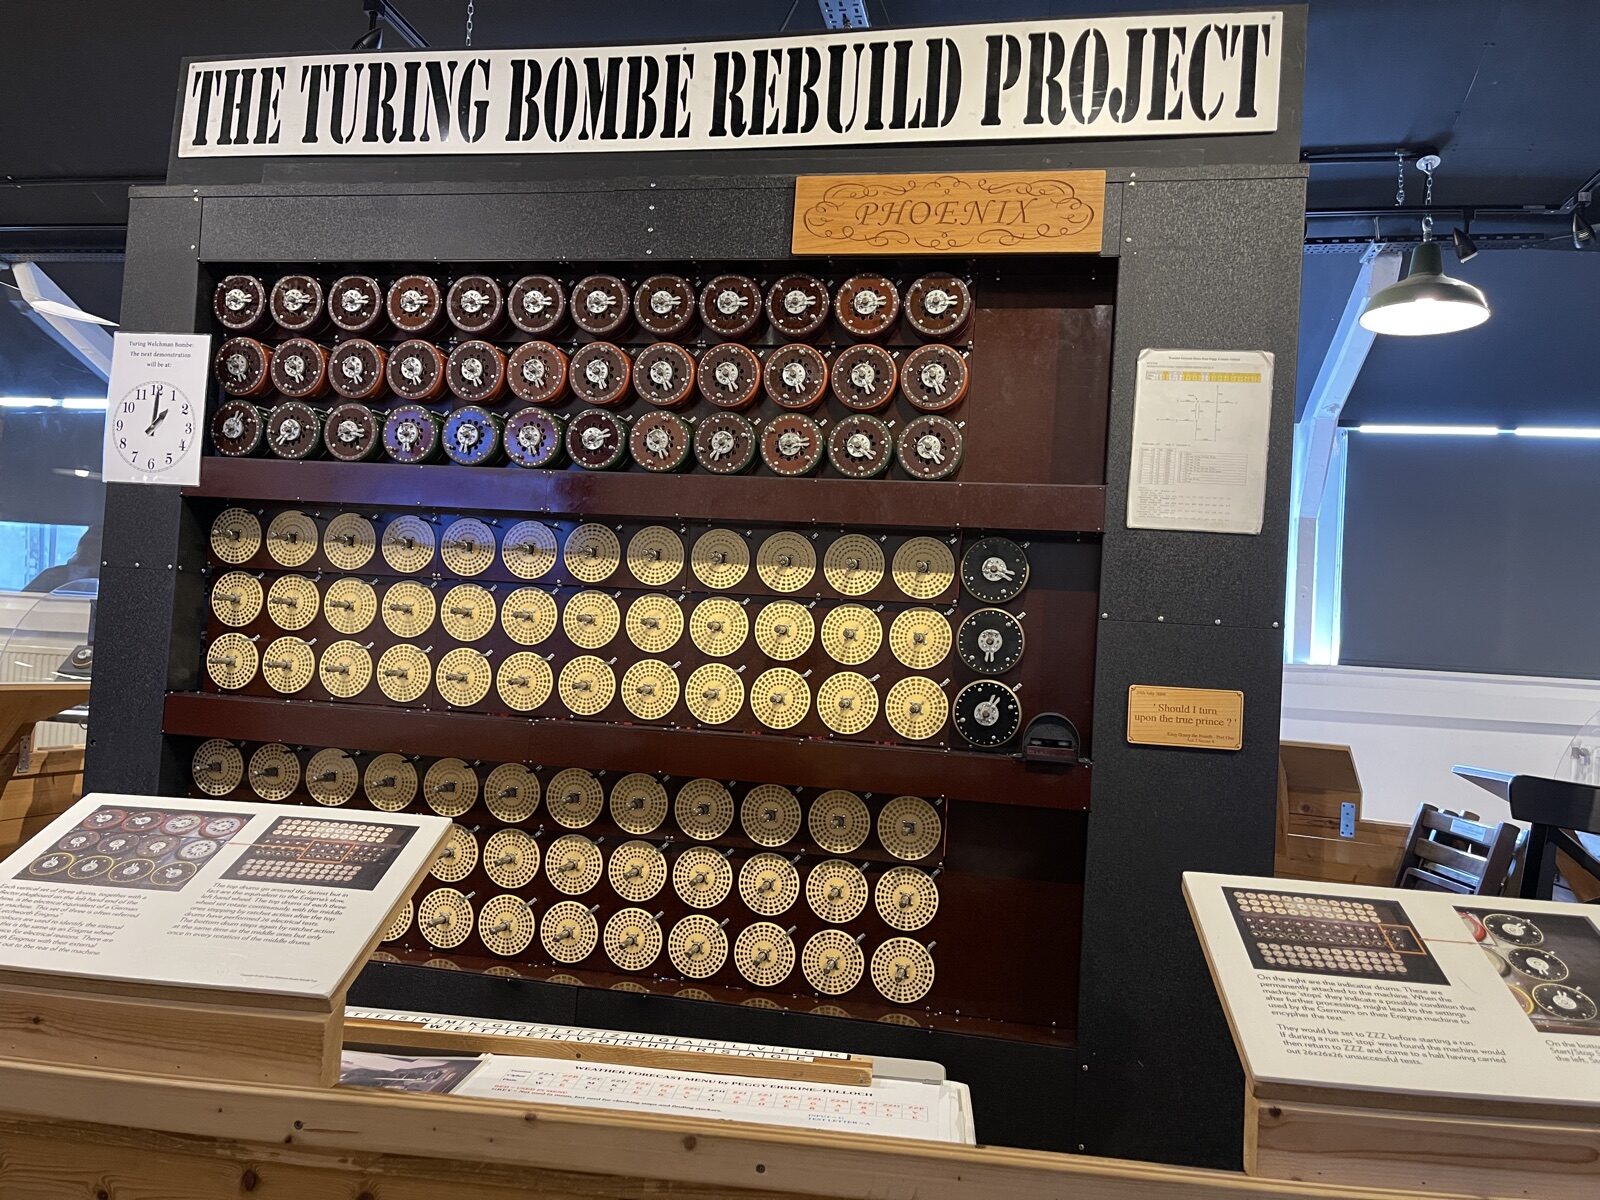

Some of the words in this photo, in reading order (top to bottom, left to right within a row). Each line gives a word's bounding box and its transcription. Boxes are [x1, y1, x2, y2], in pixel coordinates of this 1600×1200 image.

[192, 66, 286, 146] THE
[301, 58, 491, 144] TURING
[505, 53, 694, 143] BOMBE
[708, 37, 962, 138] REBUILD
[980, 23, 1270, 126] PROJECT
[855, 198, 1038, 226] PHOENIX
[136, 389, 146, 400] 11
[151, 385, 163, 396] 12
[171, 390, 176, 401] 1
[123, 402, 135, 413] 10
[182, 404, 188, 415] 2
[116, 420, 123, 431] 9
[185, 423, 192, 434] 3
[120, 438, 127, 448] 8
[179, 440, 186, 451] 4
[132, 452, 138, 463] 7
[166, 453, 173, 464] 5
[148, 459, 155, 470] 6
[1158, 703, 1190, 713] Should
[1192, 705, 1196, 713] I
[1199, 707, 1217, 715] turn
[1135, 715, 1156, 723] upon
[1159, 715, 1173, 723] the
[1176, 716, 1193, 724] true
[1196, 717, 1224, 726] prince
[1260, 982, 1309, 991] permanently
[1312, 986, 1346, 994] attached
[1337, 981, 1372, 989] indicator
[1403, 986, 1429, 994] These
[1286, 996, 1313, 1005] further
[1324, 993, 1343, 1001] they
[1344, 995, 1376, 1003] indicate
[1419, 1002, 1457, 1010] condition
[1272, 1011, 1308, 1019] encypher
[1317, 1006, 1355, 1015] Germans
[1390, 1012, 1422, 1021] Enigma
[1424, 1016, 1459, 1024] machine
[1277, 1024, 1299, 1033] They
[1366, 1031, 1387, 1039] ZZZ
[1419, 1038, 1451, 1046] starting
[1288, 1033, 1316, 1042] during
[1400, 1042, 1425, 1050] found
[1443, 1046, 1479, 1054] machine
[1303, 1050, 1343, 1058] 26x26x26
[1345, 1054, 1398, 1063] unsuccessful
[1304, 1042, 1330, 1050] return
[1343, 1044, 1364, 1052] ZZZ
[1446, 1053, 1476, 1062] having
[576, 1066, 625, 1074] WEATHER
[628, 1071, 682, 1081] FORECAST
[770, 1084, 873, 1097] ERSKINE-TULLOCH
